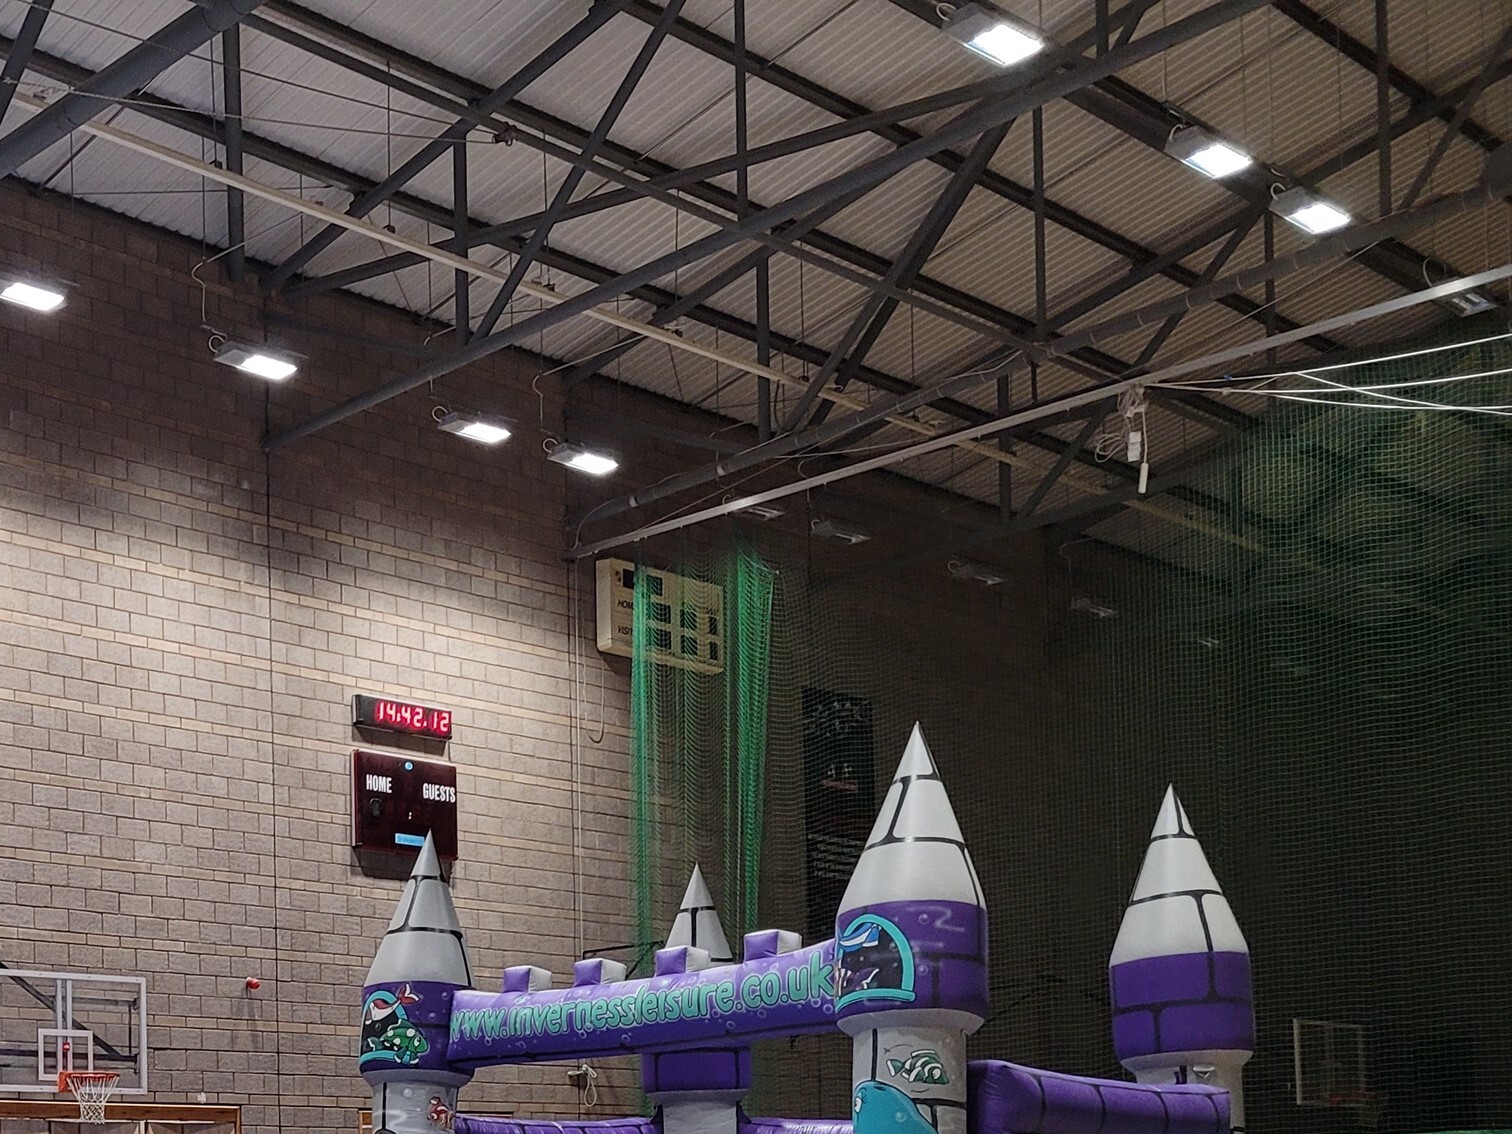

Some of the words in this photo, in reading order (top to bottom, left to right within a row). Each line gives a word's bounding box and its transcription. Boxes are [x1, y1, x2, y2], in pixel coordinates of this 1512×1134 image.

[365, 773, 392, 794] HOME
[422, 782, 456, 803] GUESTS
[449, 951, 836, 1041] www.invernessleisure.co.uk
